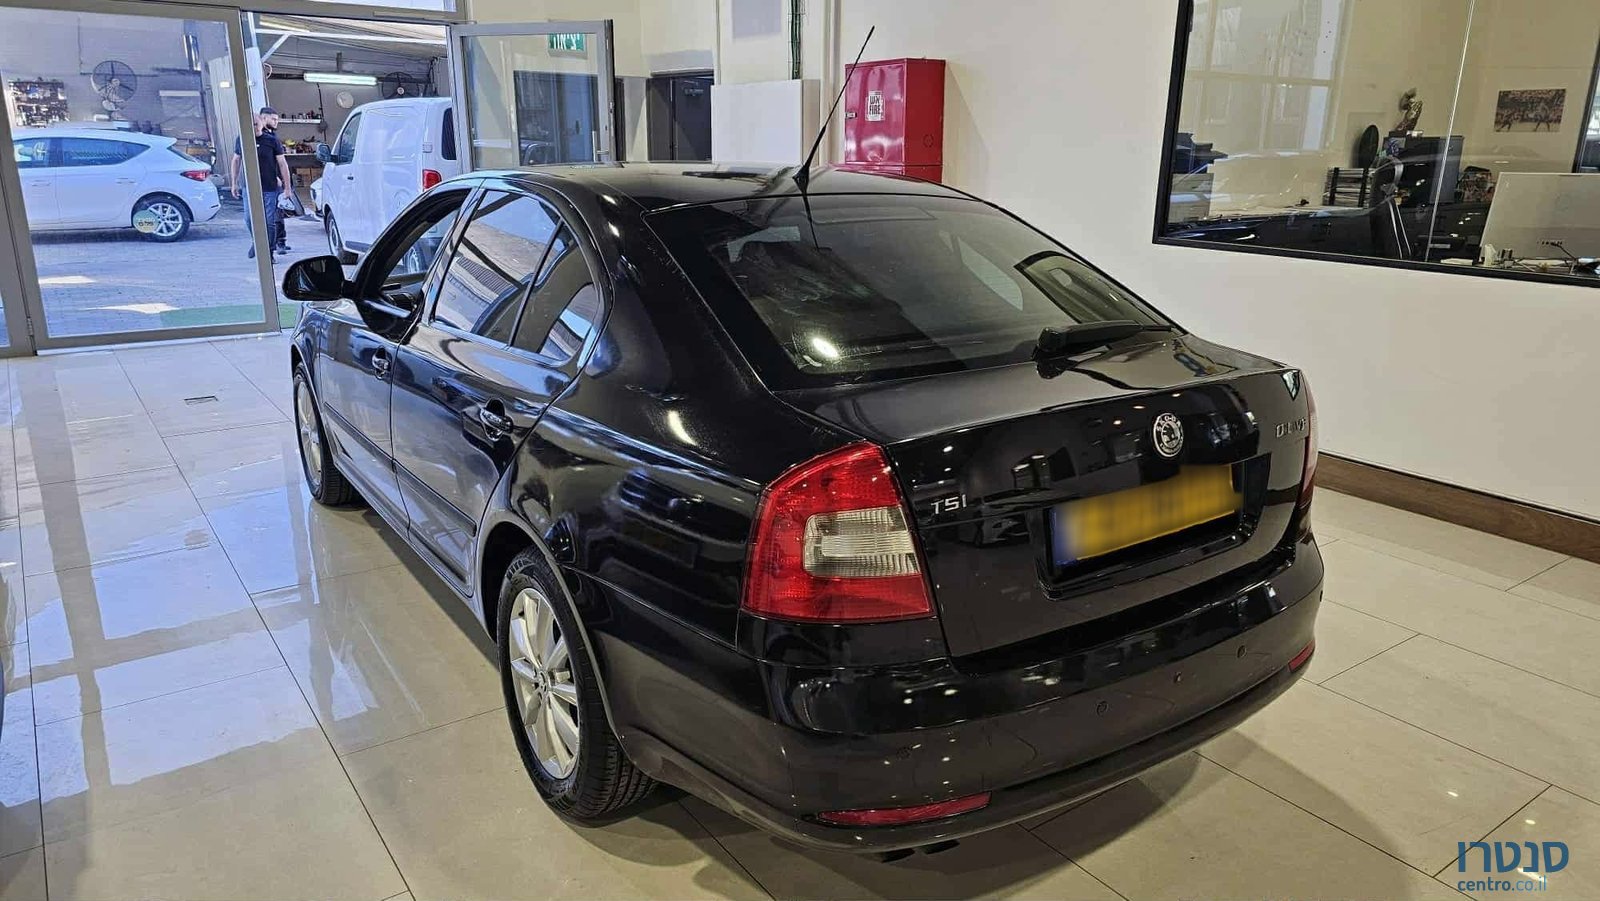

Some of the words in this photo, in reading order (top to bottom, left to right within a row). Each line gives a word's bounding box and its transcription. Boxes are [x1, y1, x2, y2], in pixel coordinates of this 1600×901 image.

[869, 96, 880, 104] אש
[869, 105, 881, 115] FIRE
[930, 494, 967, 515] TSI
